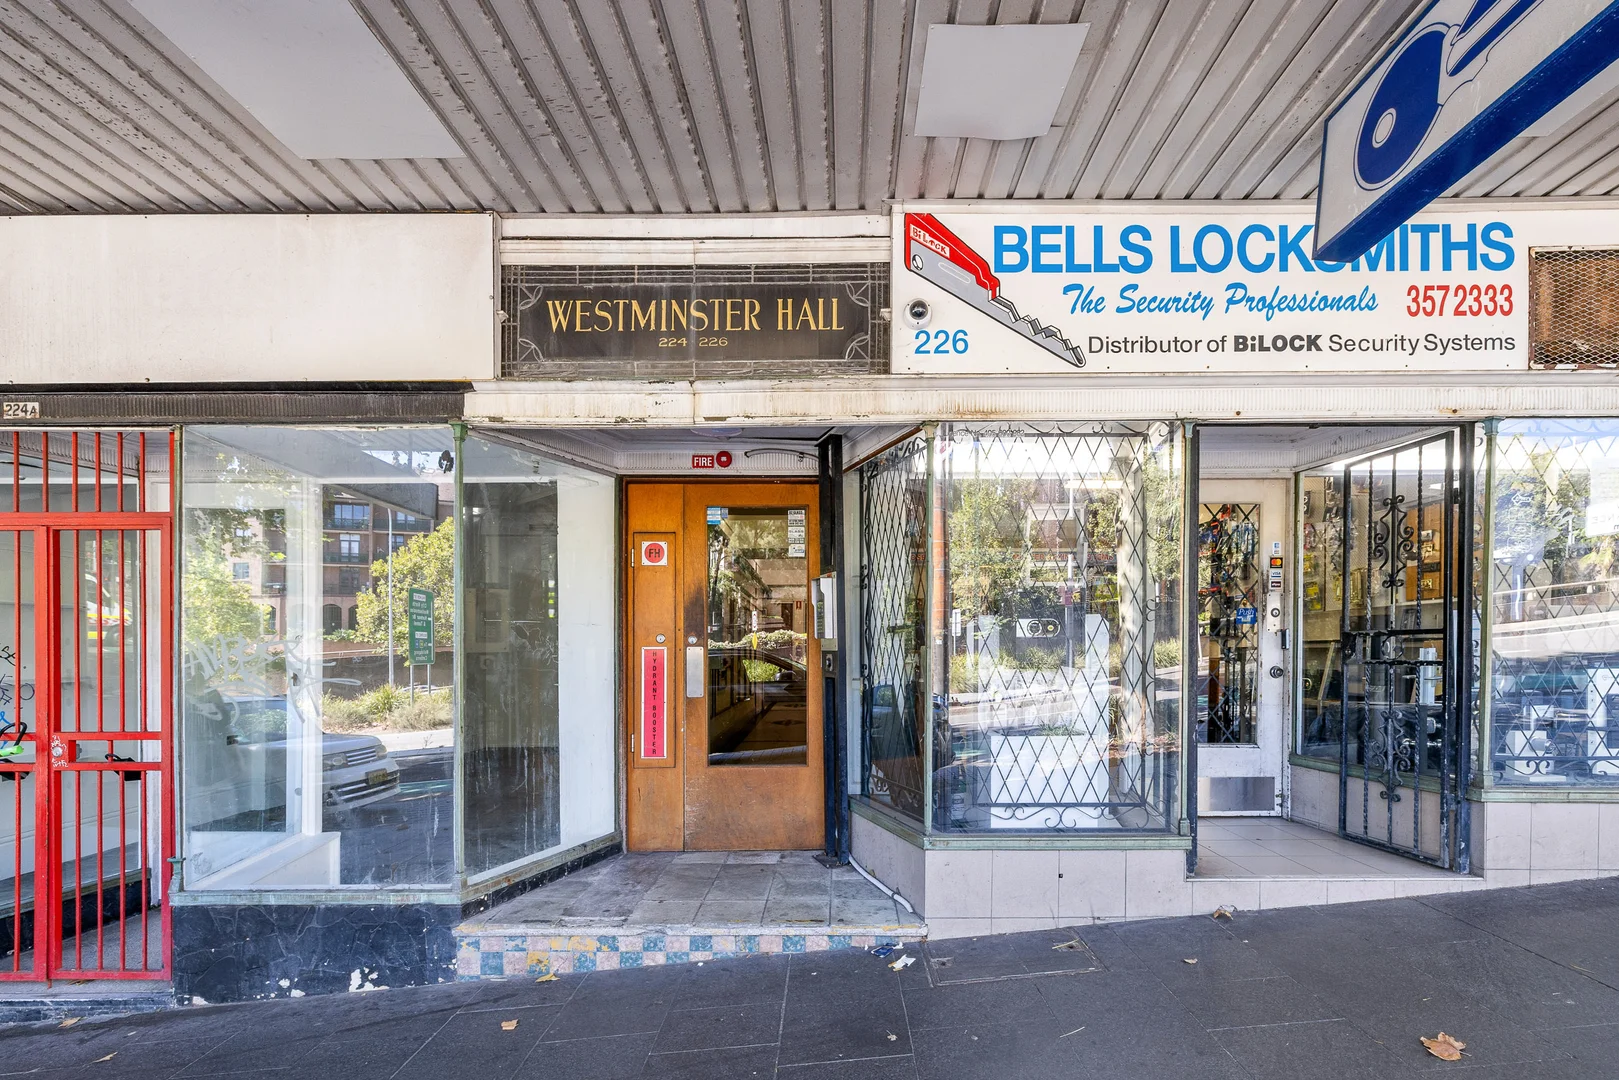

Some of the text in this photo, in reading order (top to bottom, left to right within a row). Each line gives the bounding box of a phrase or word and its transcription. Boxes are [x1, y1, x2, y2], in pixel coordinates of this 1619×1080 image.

[993, 223, 1516, 275] BELLS LOCKMITHS
[1062, 281, 1379, 322] The Security Professionals
[546, 297, 844, 332] WESTMINSTER HALL
[658, 337, 728, 348] 224 226
[914, 329, 969, 355] 226
[1088, 333, 1516, 356] Distributor of BiLOCK Security Systems
[5, 403, 37, 417] 224A
[693, 456, 713, 467] FIRE
[648, 548, 661, 558] FH
[1238, 608, 1255, 616] Push
